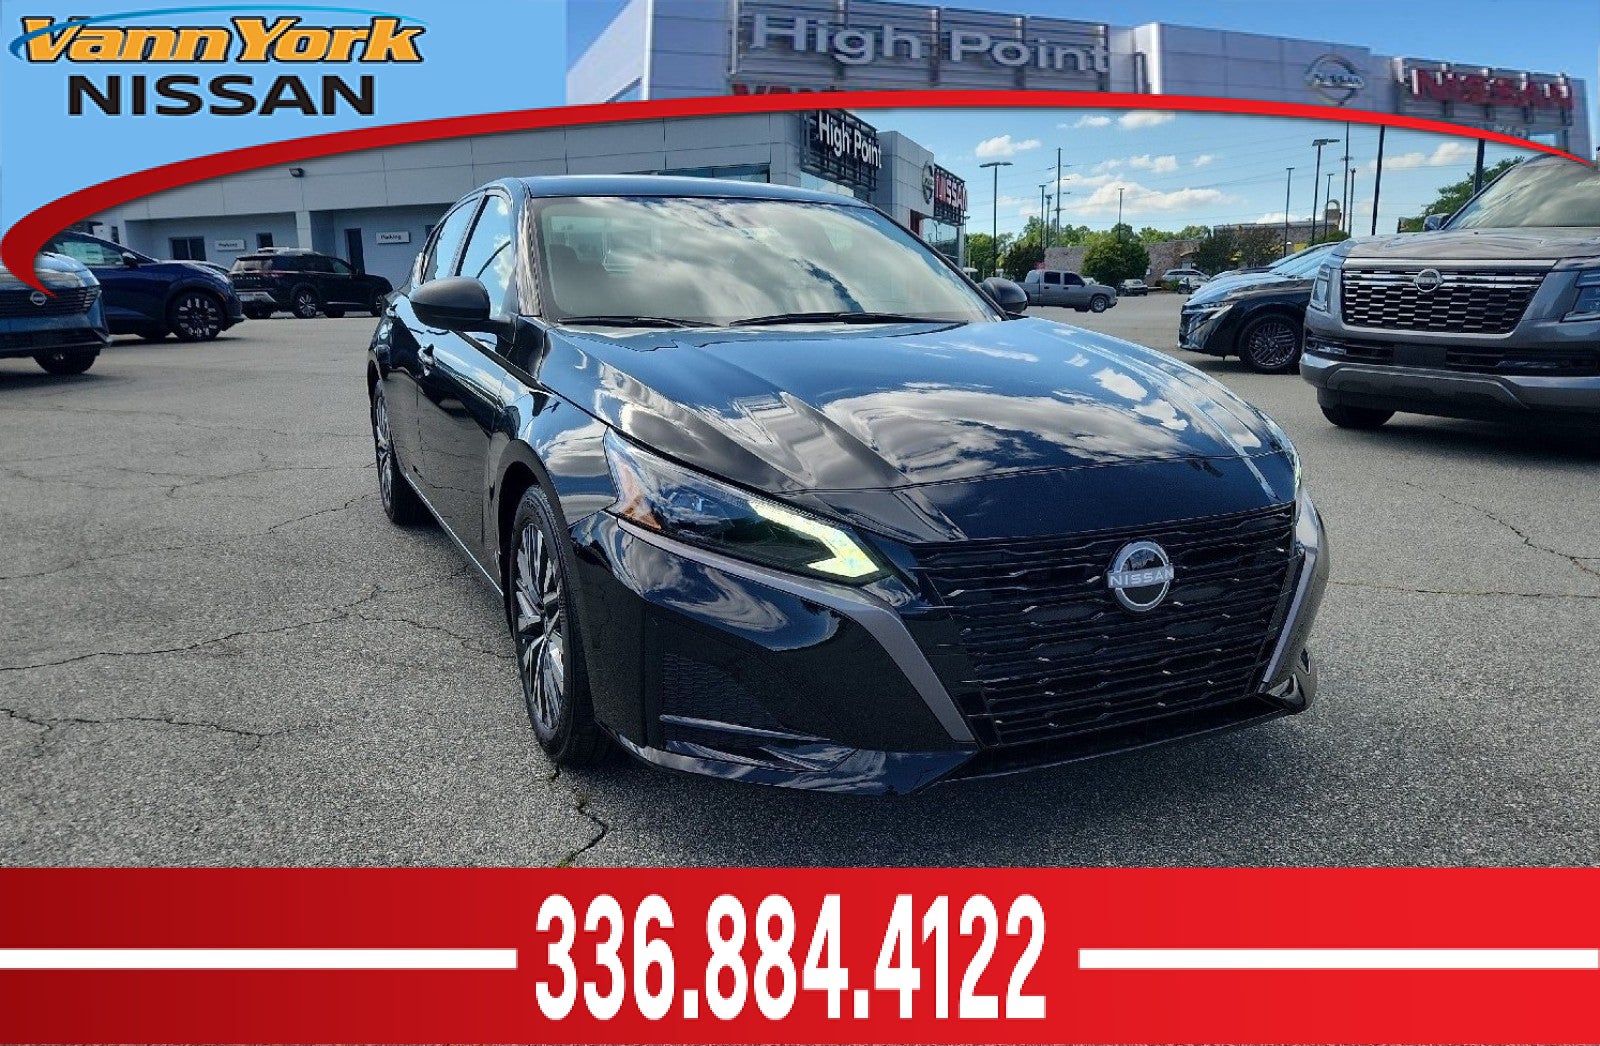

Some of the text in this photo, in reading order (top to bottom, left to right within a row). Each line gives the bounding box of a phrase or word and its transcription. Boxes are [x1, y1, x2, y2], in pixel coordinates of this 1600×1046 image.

[750, 13, 1110, 73] High Point
[818, 110, 882, 169] High Point
[1109, 568, 1174, 586] NISSAN
